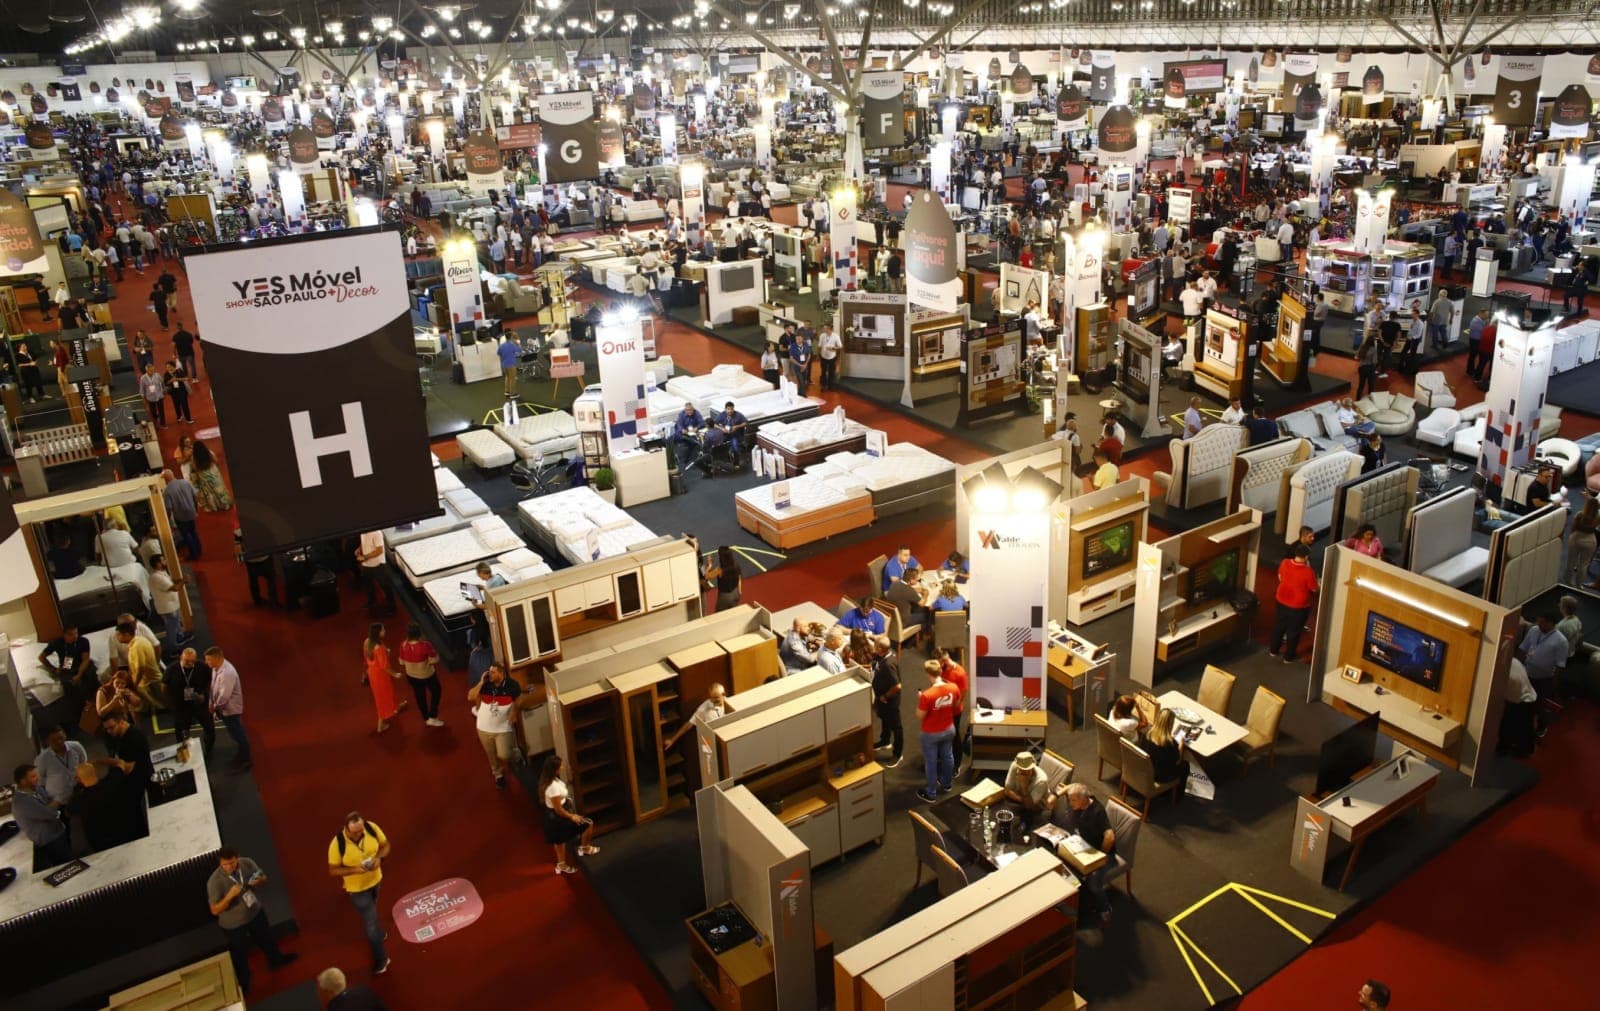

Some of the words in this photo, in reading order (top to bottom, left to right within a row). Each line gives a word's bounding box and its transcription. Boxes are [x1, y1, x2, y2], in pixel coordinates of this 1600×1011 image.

[67, 87, 76, 97] H
[1098, 76, 1107, 90] 5
[1507, 90, 1522, 108] 3
[880, 112, 893, 134] F
[560, 139, 583, 164] G
[289, 266, 362, 292] Móvel
[225, 299, 253, 309] SHOW
[284, 290, 327, 304] PAULO
[288, 400, 374, 489] H
[426, 895, 467, 916] Bahia
